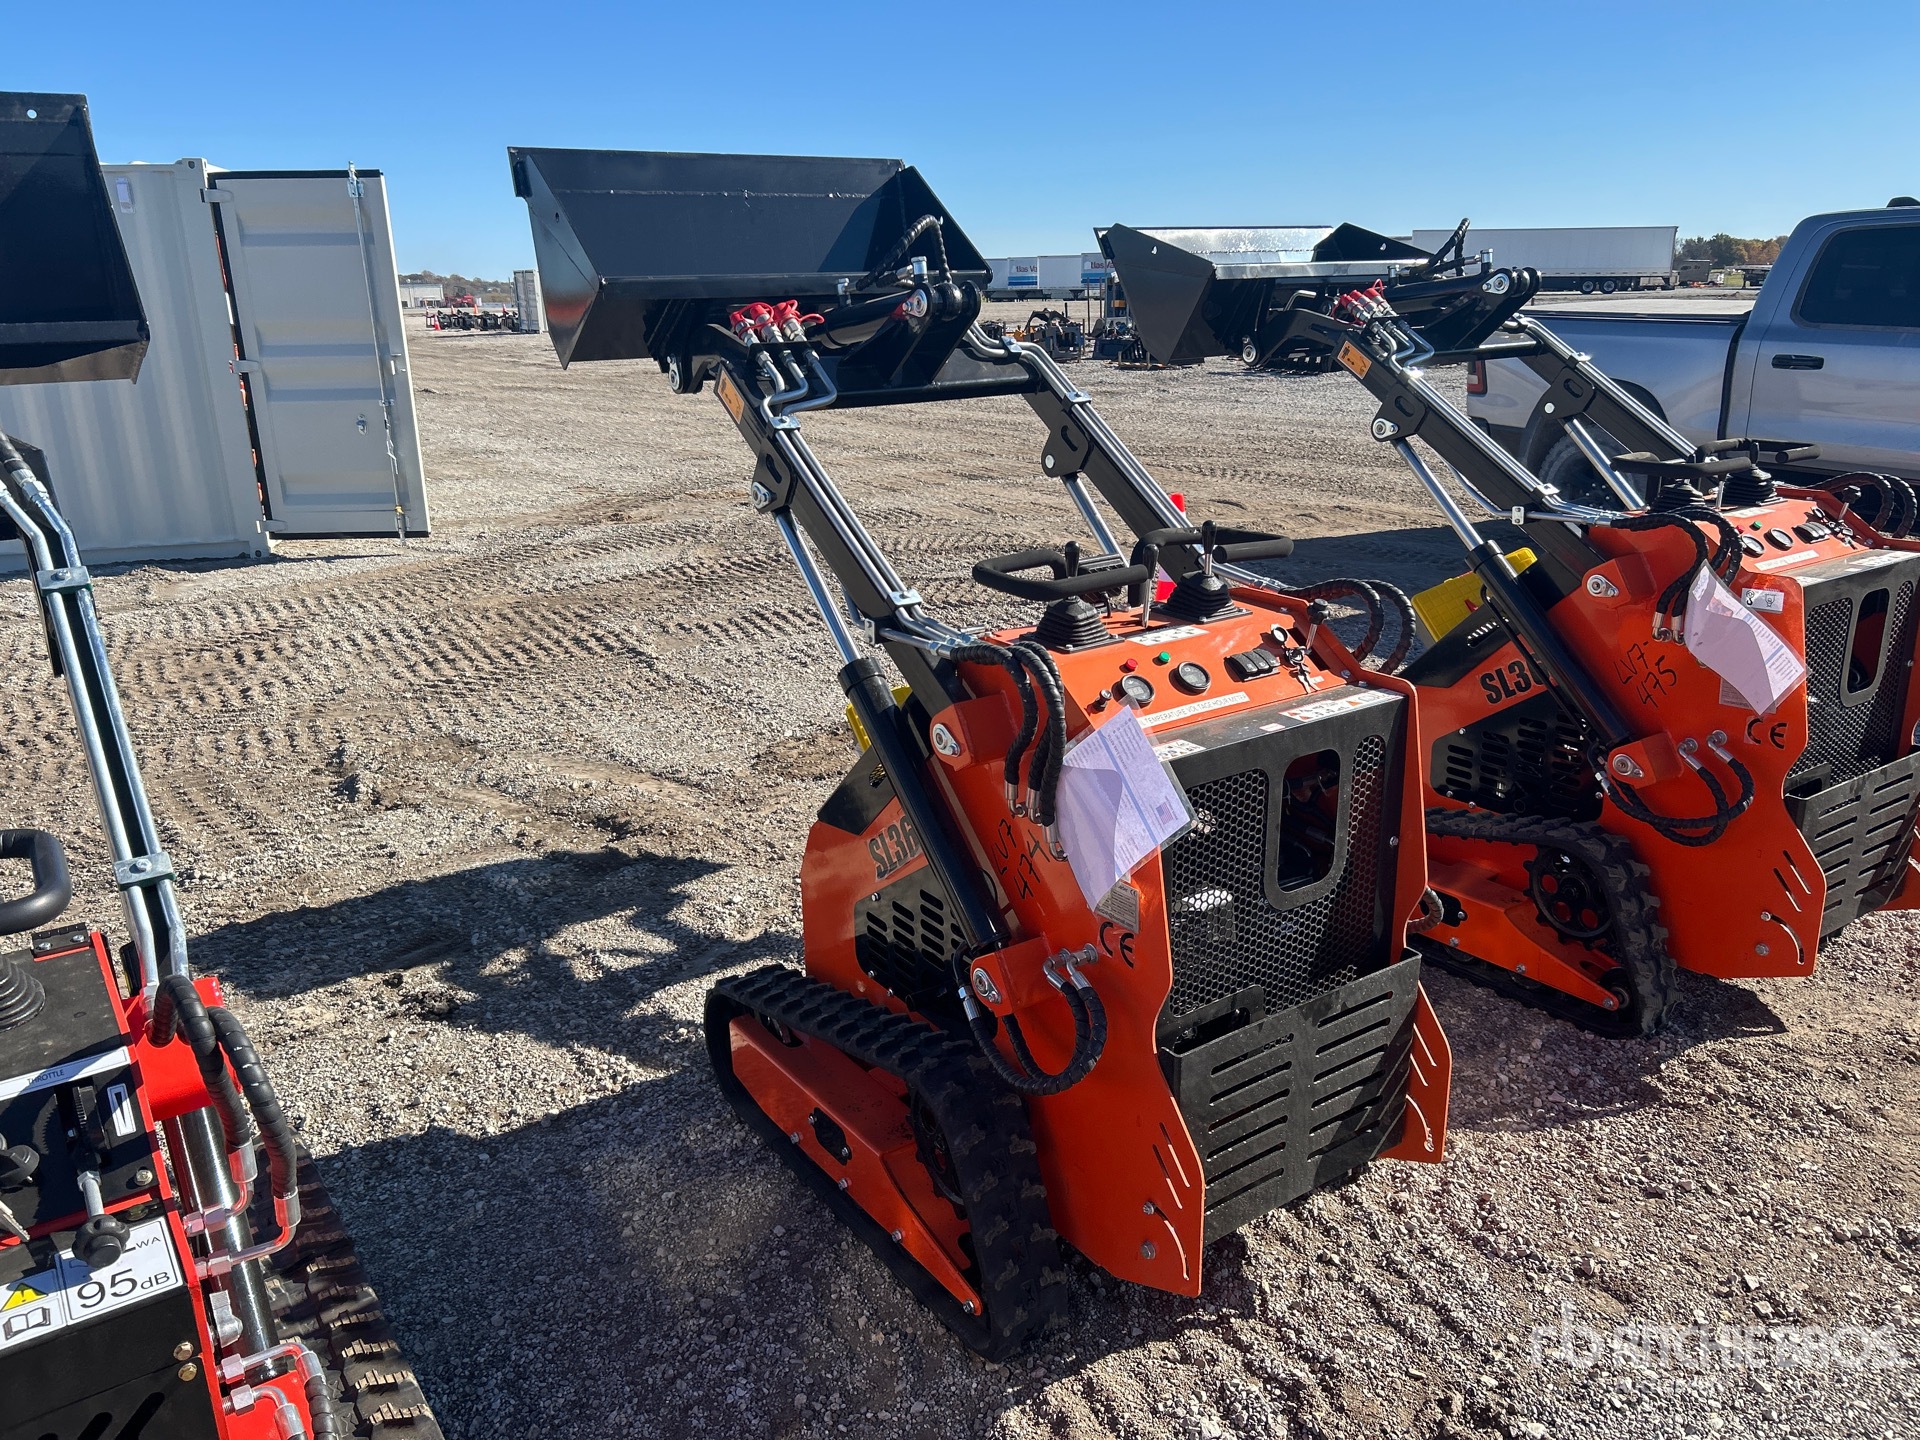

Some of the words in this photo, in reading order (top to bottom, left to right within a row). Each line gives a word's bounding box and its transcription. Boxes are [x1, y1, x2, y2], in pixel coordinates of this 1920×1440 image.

[1636, 655, 1678, 708] 475
[1144, 709, 1187, 724] TEMPERATURE
[1187, 700, 1212, 714] VOLTAGE
[1013, 829, 1051, 899] 474
[27, 1069, 65, 1085] THROTTLE
